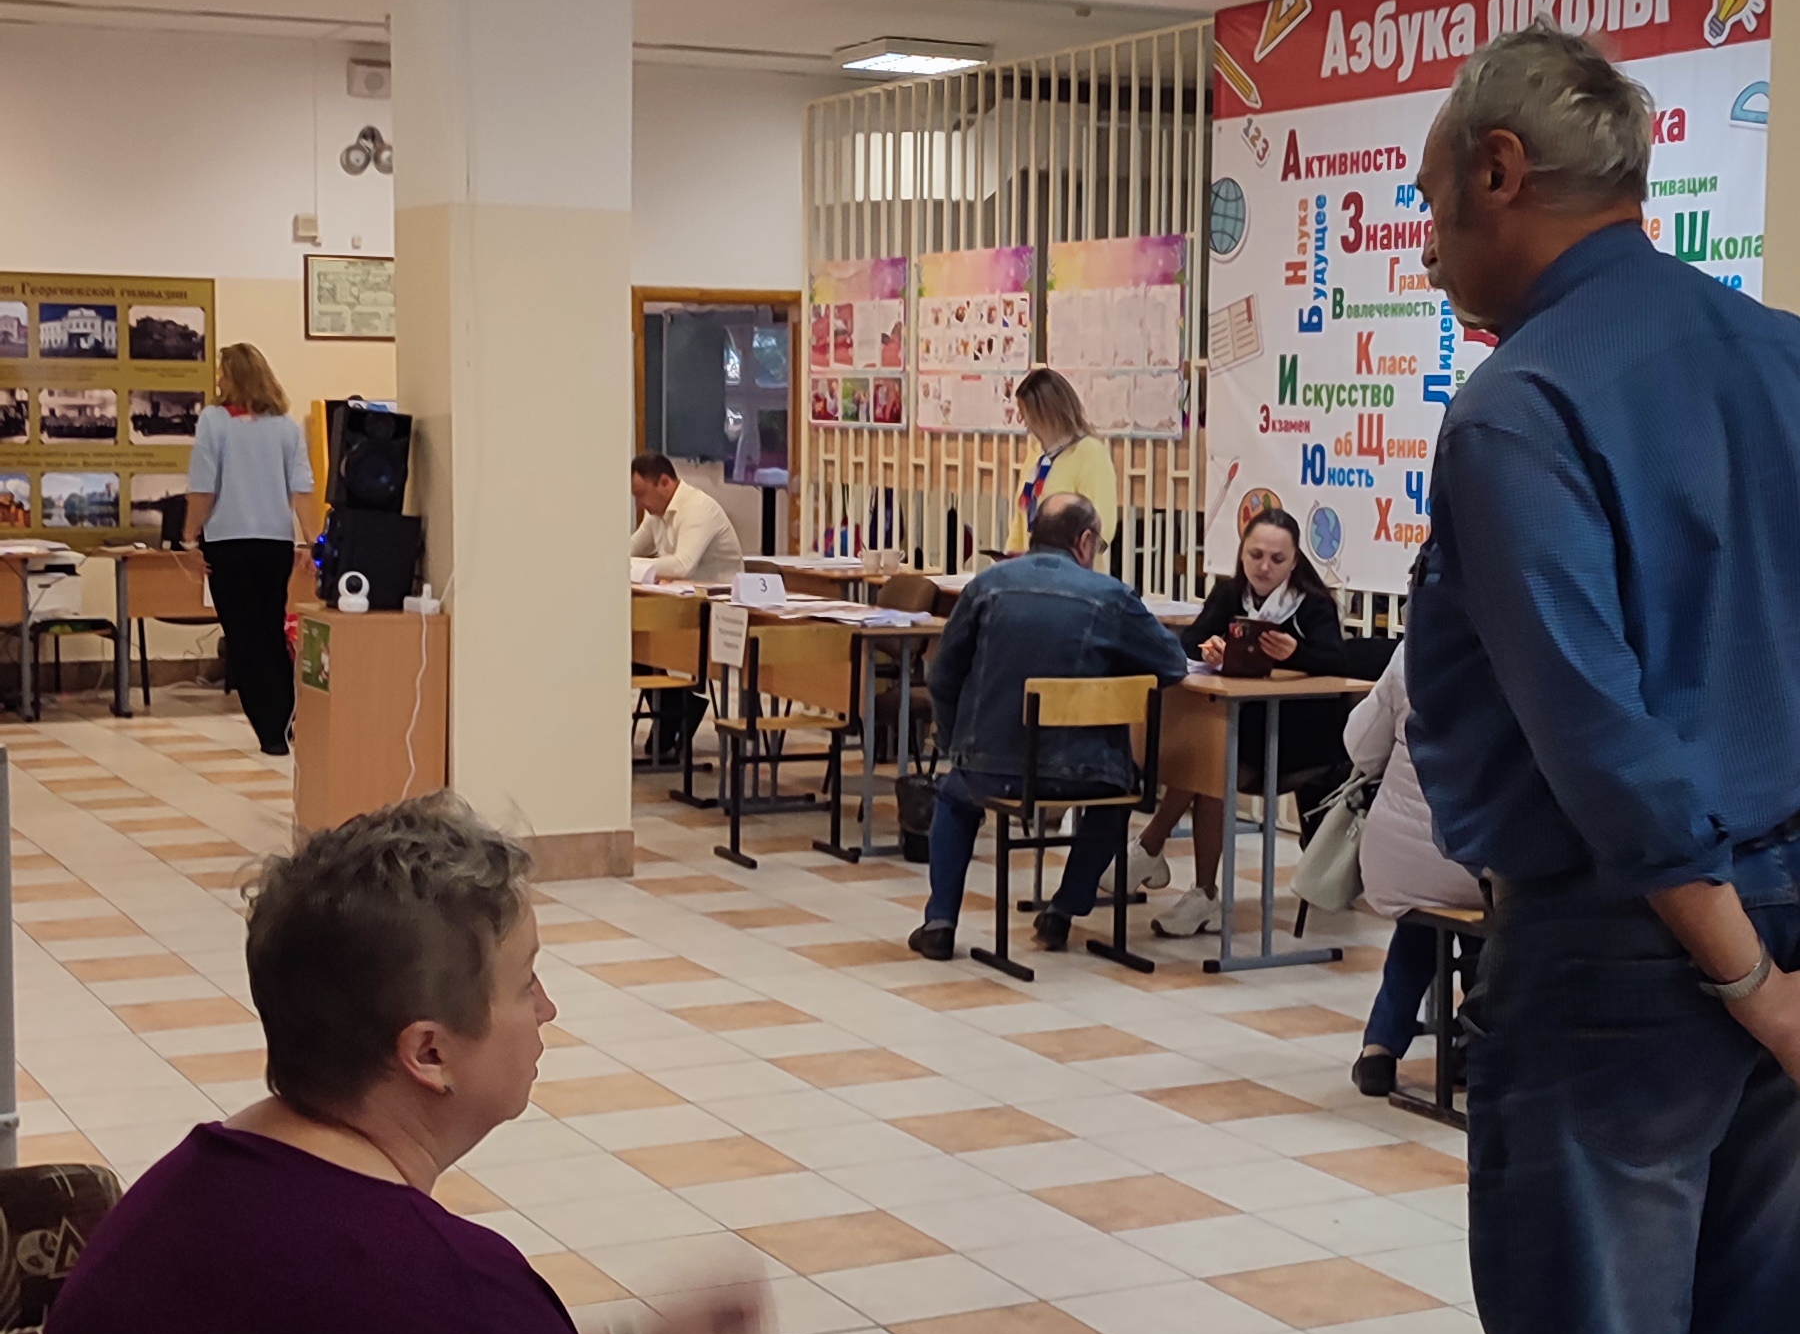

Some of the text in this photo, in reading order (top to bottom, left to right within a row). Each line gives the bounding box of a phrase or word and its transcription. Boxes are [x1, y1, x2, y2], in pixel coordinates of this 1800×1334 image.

[1320, 0, 1475, 83] Азбука
[1281, 128, 1407, 182] Активность
[1395, 184, 1429, 212] др
[1650, 175, 1718, 197] тивация
[1284, 198, 1310, 285] Наука
[1675, 210, 1764, 262] Школа
[1298, 194, 1329, 333] Будущее
[1389, 257, 1437, 296] Граж
[1332, 287, 1436, 319] Вовлеченность
[1356, 331, 1418, 375] Класс
[1278, 354, 1395, 414] Искусство
[1259, 404, 1311, 433] Экзамен
[1300, 443, 1375, 488] Юность
[759, 577, 768, 593] 3
